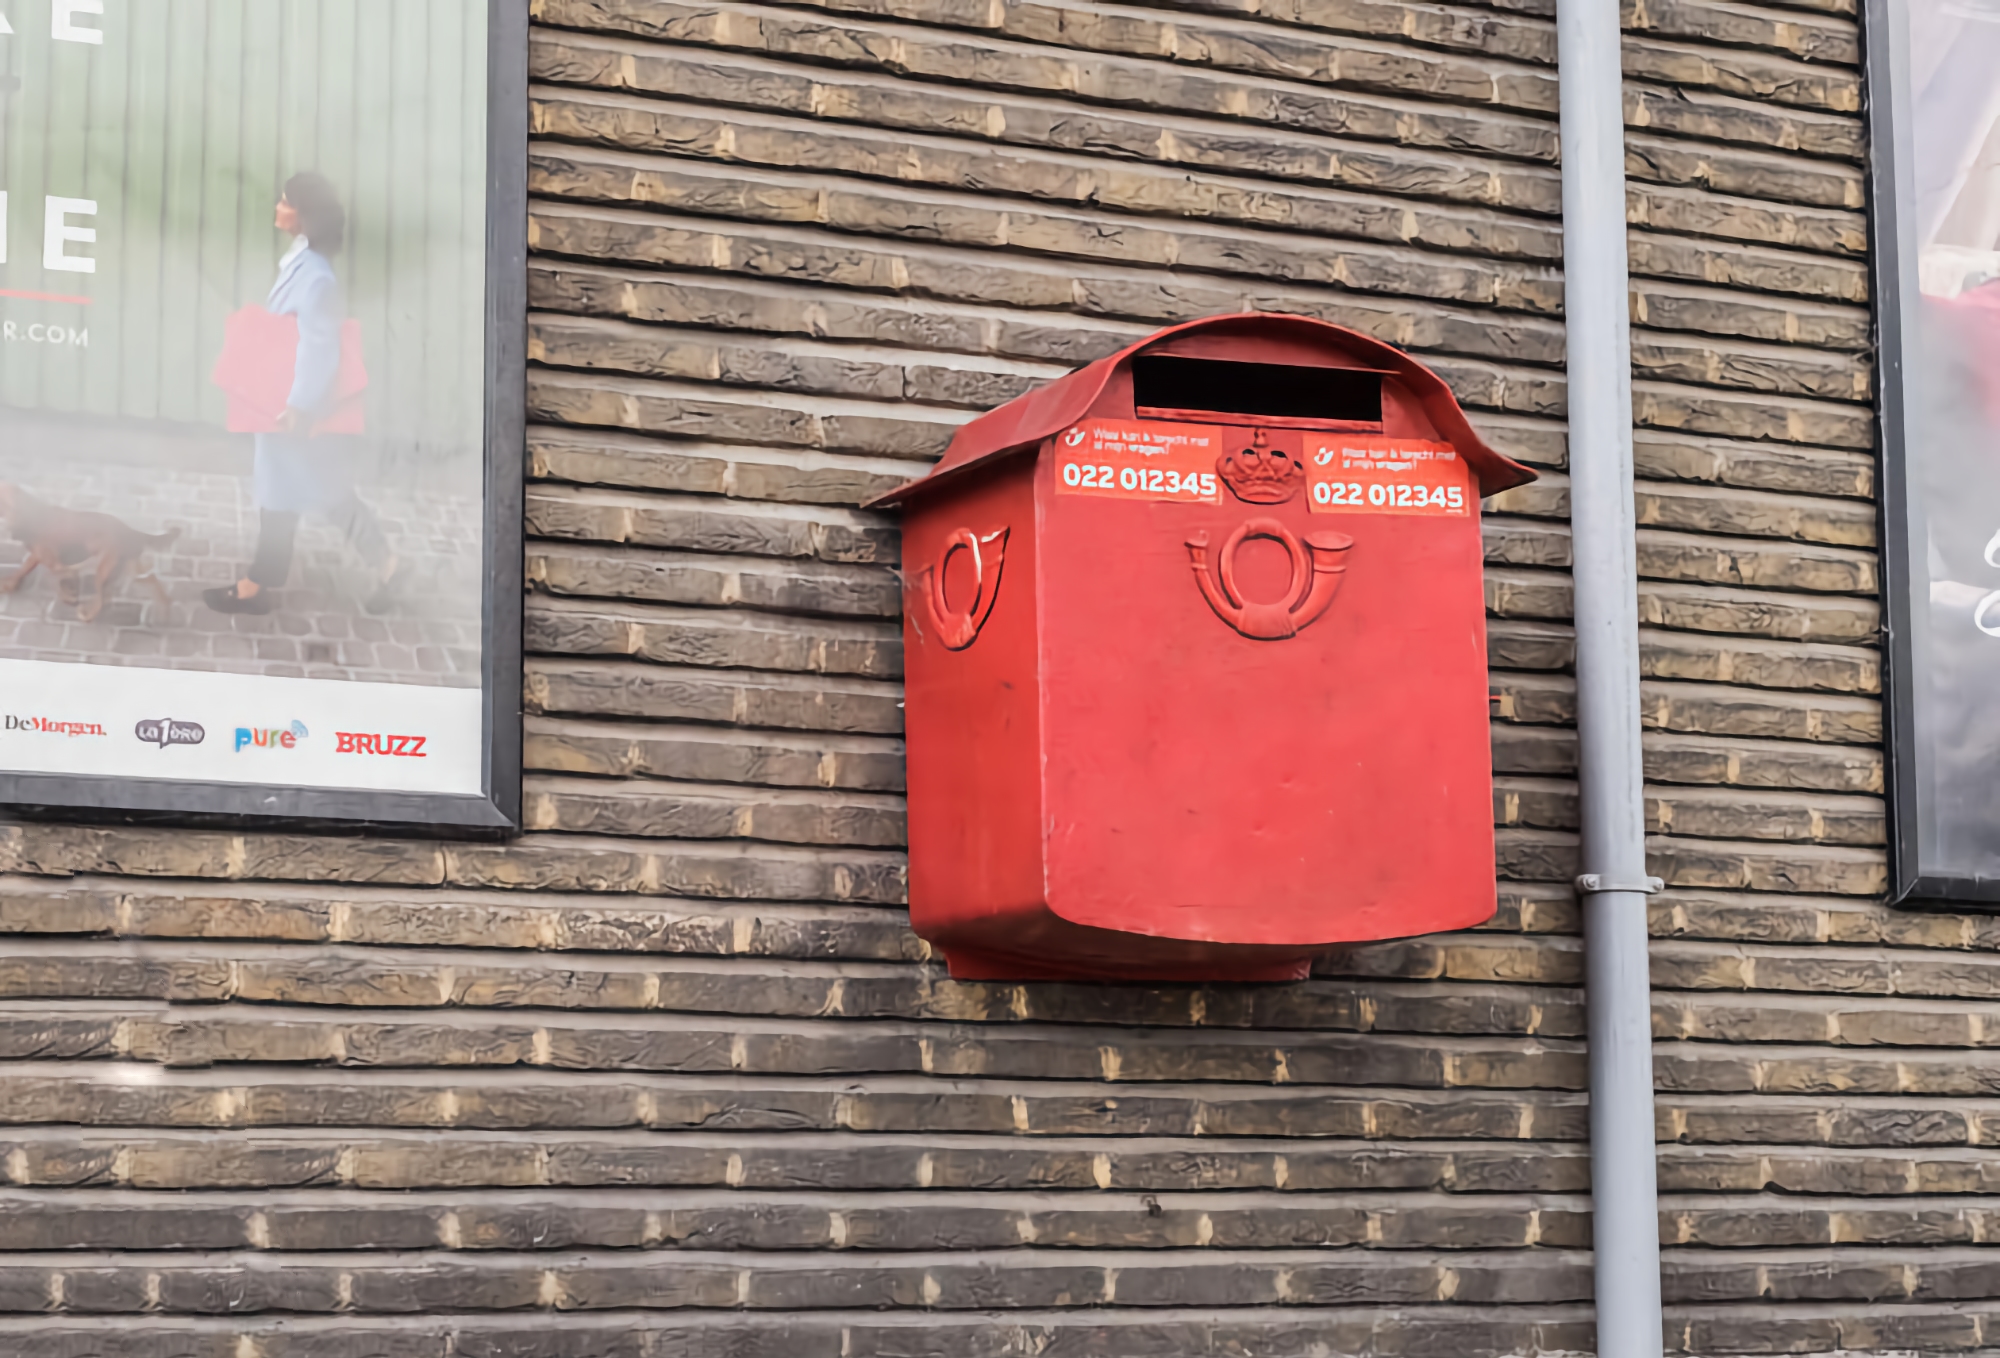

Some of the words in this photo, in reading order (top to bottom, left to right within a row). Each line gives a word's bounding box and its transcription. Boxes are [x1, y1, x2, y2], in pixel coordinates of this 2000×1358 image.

[0, 190, 97, 273] E
[1063, 463, 1115, 489] 022
[1120, 467, 1217, 496] 012345
[1313, 482, 1364, 506] 022
[1368, 484, 1464, 508] 012345
[234, 727, 297, 753] pure
[335, 731, 427, 757] BRUZZ
